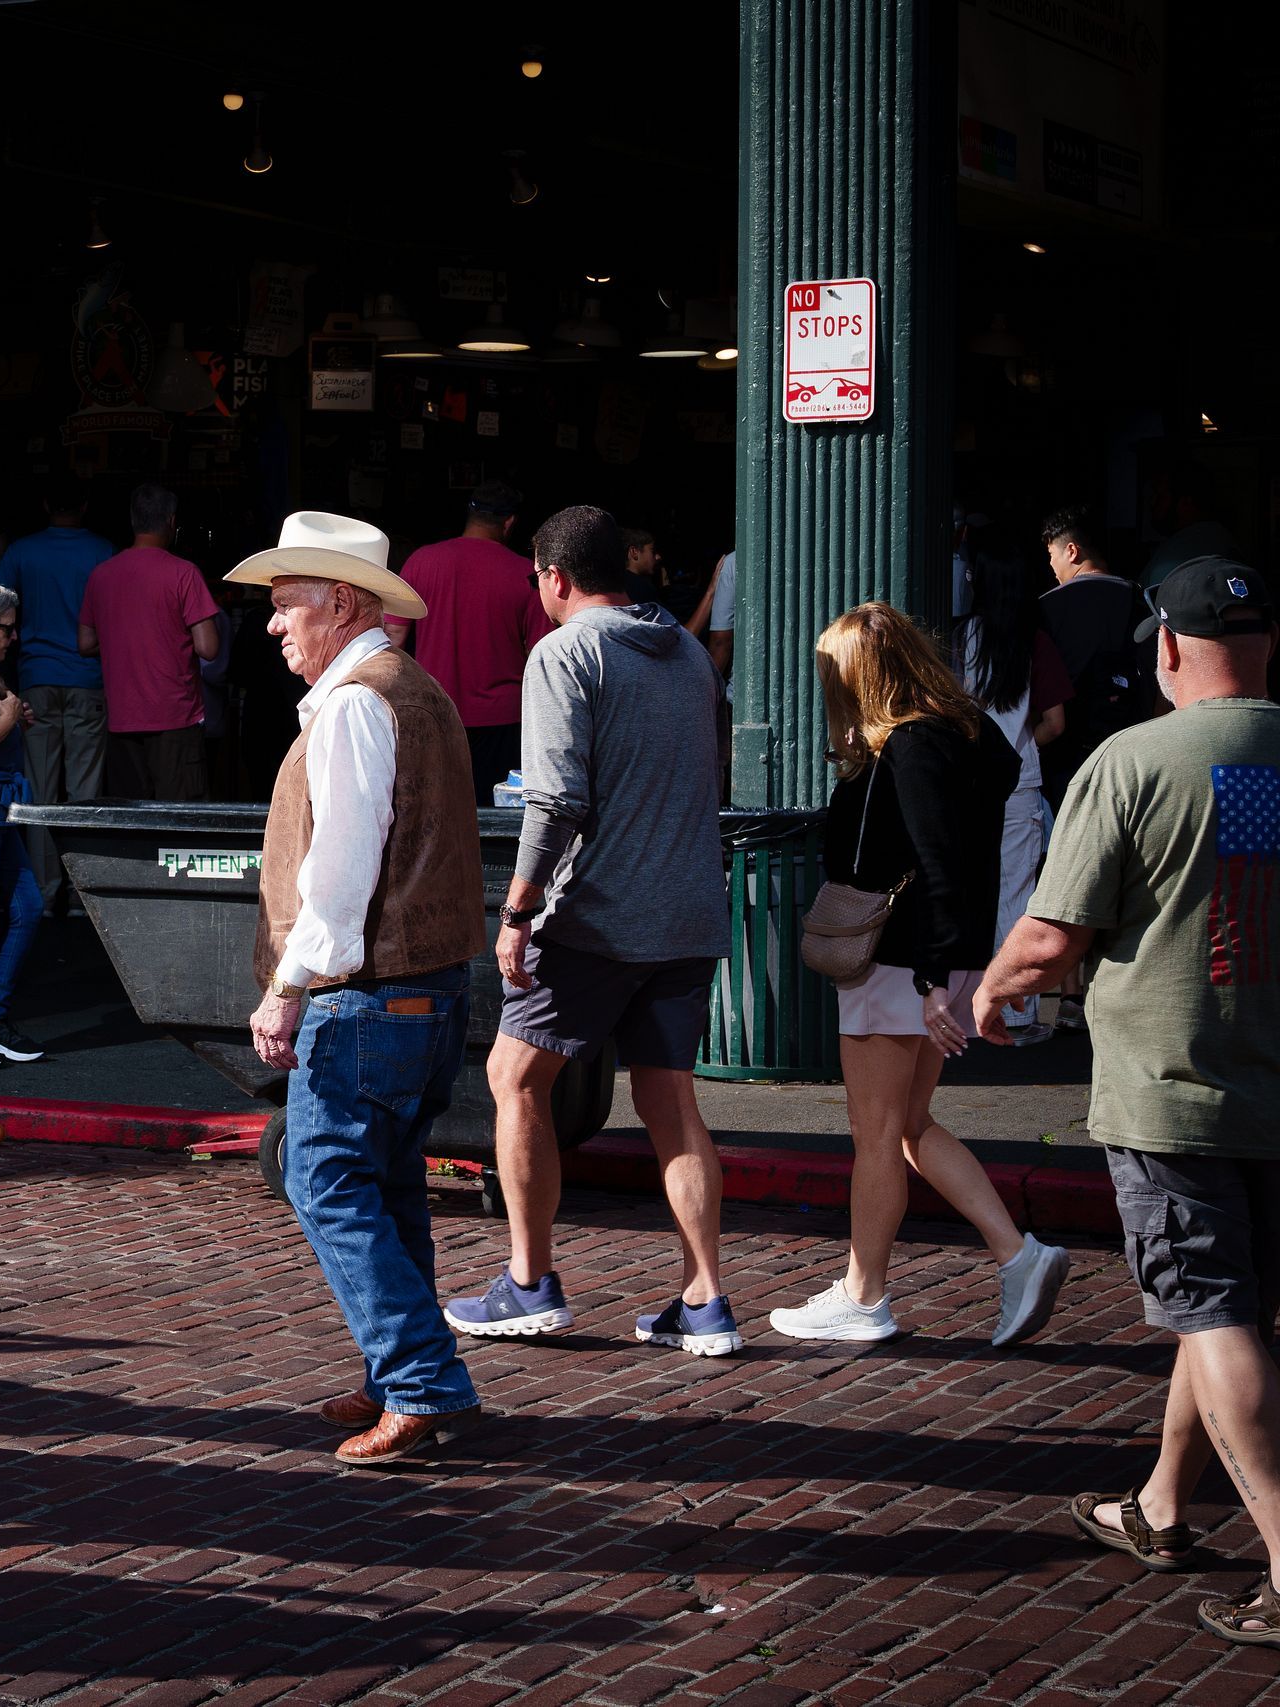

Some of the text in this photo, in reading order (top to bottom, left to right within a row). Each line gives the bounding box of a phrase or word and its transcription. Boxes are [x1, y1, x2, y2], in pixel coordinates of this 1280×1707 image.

[792, 289, 815, 308] NO
[797, 314, 863, 339] STOPS
[164, 853, 241, 873] FLATTEN
